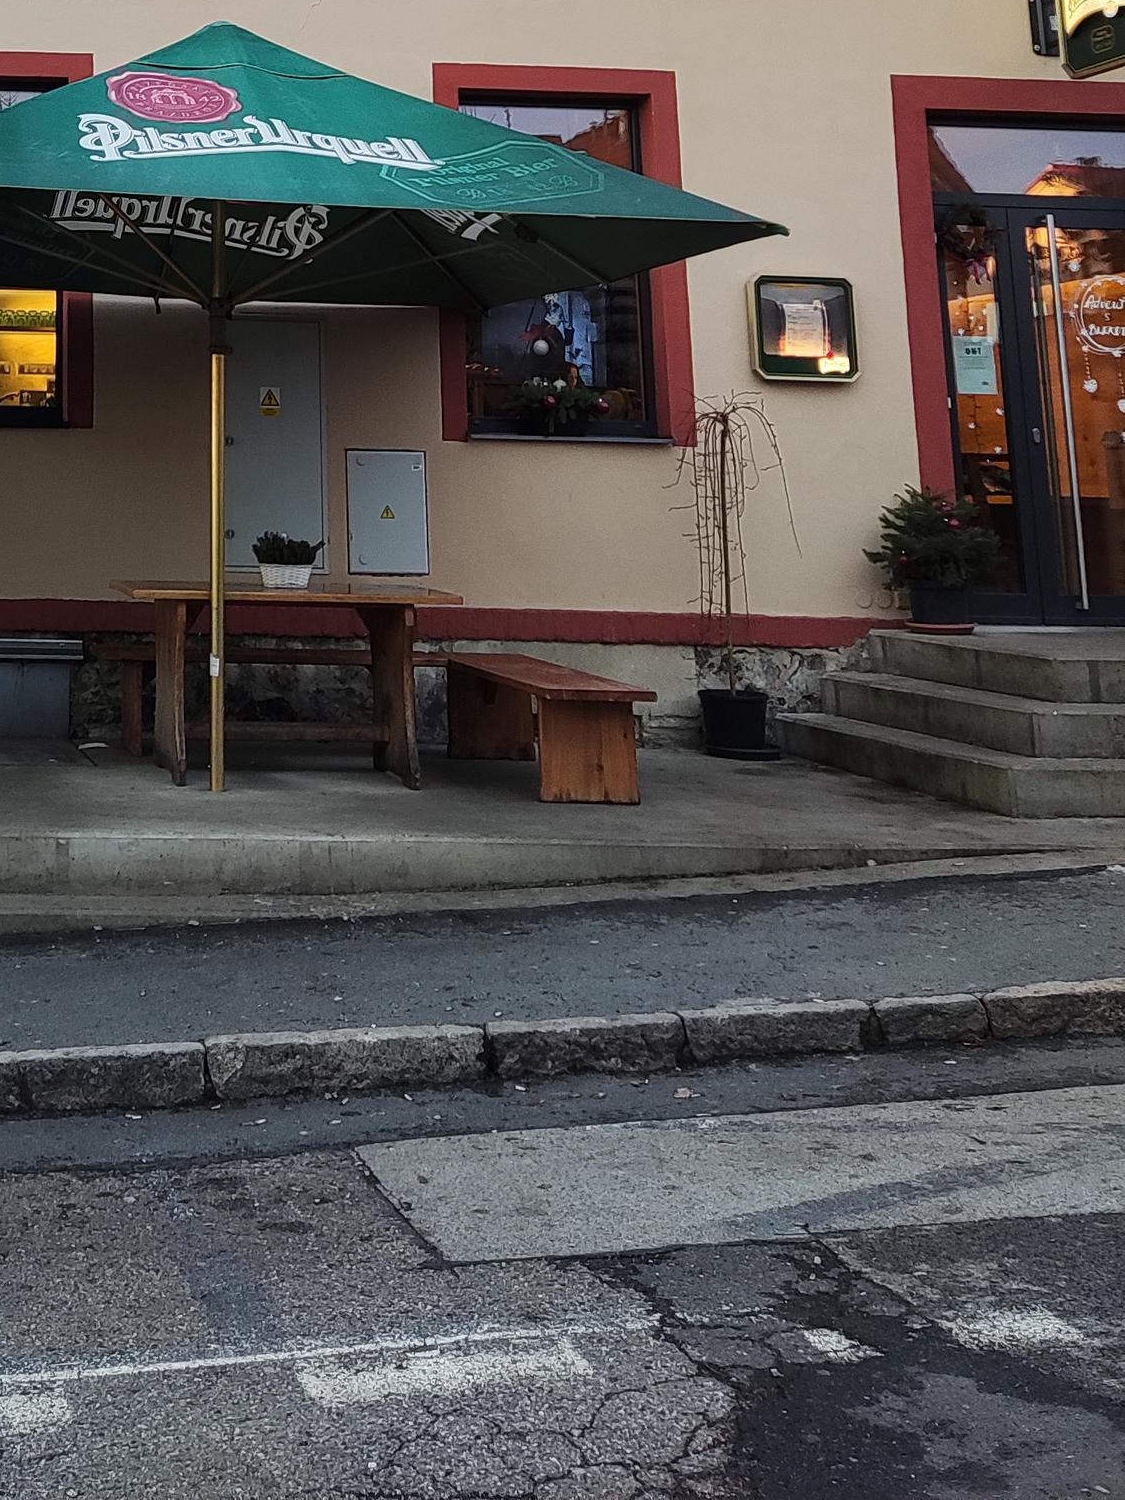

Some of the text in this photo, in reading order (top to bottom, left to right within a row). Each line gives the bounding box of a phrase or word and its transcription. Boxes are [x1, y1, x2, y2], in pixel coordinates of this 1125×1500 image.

[77, 113, 438, 167] Pilsner Urquell
[502, 158, 561, 177] Bier
